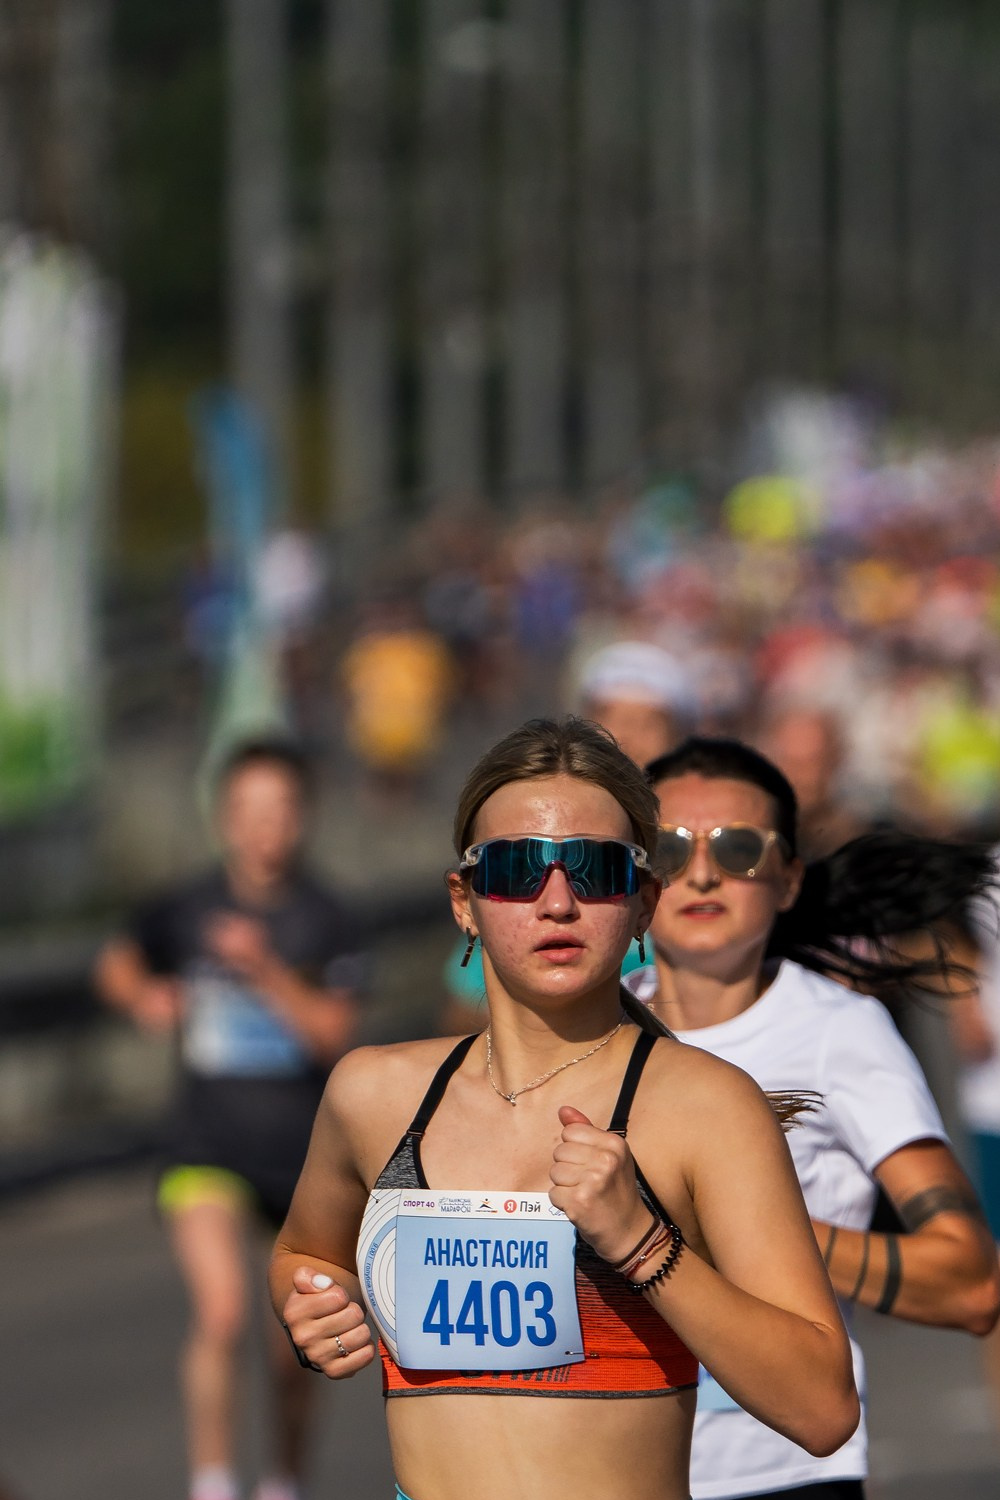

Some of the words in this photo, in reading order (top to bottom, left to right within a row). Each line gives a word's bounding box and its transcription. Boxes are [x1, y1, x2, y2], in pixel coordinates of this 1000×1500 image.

[403, 1200, 426, 1208] СПОРТ
[520, 1201, 541, 1212] Пэй
[424, 1238, 548, 1268] АНАСТАСИЯ
[423, 1279, 557, 1347] 4403
